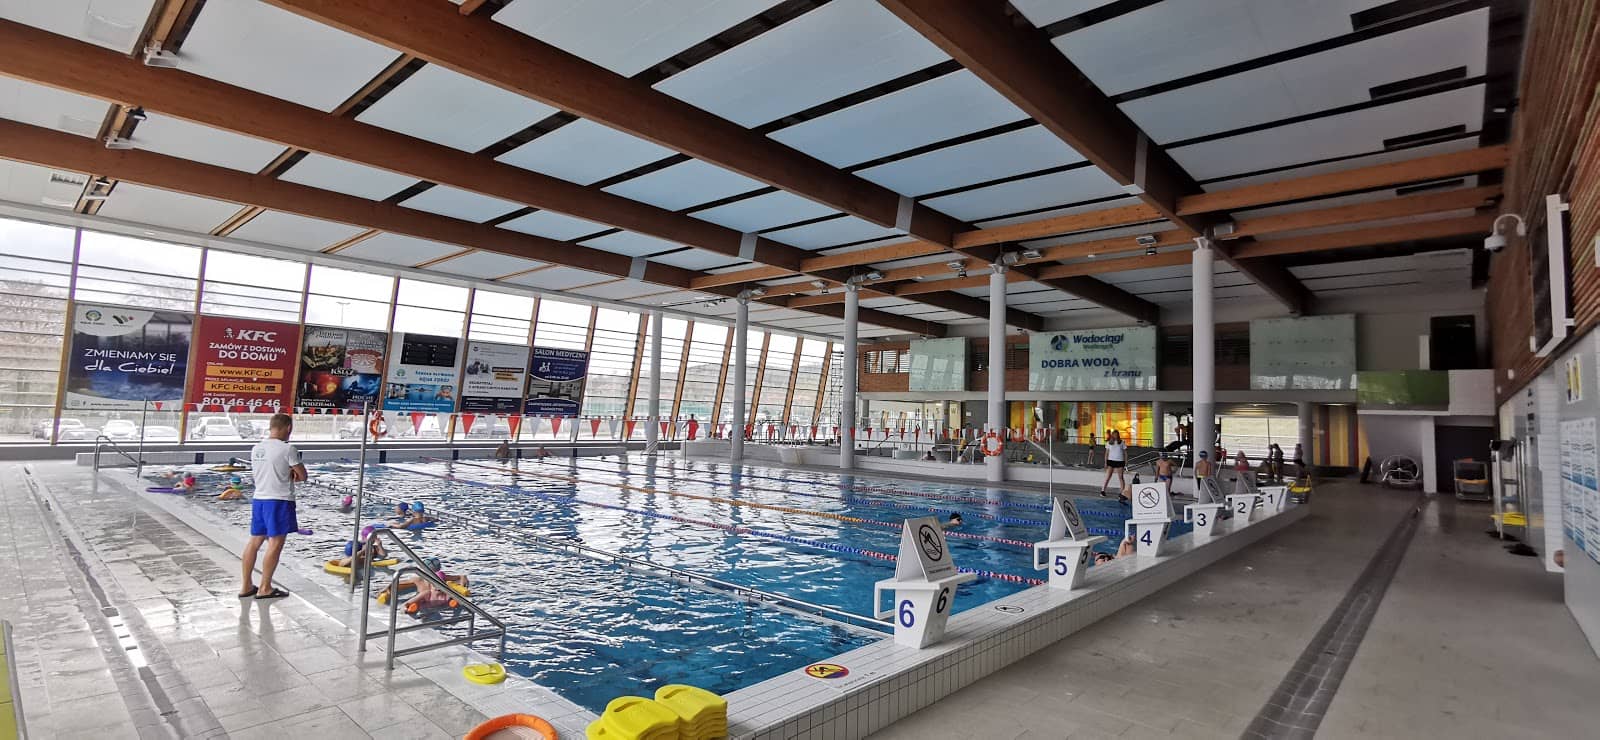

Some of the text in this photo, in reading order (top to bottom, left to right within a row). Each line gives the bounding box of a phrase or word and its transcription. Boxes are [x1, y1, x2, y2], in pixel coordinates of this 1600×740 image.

[236, 329, 277, 342] KFC
[84, 348, 157, 361] ZMIENIAMY
[209, 342, 242, 351] ZAMÓW
[250, 346, 287, 356] DOSTAWĄ
[218, 350, 277, 361] DO DOMU
[555, 350, 586, 359] MEDYCZNY
[84, 359, 175, 375] dla Ciebie!
[1041, 358, 1119, 369] DOBRA WODA
[219, 369, 273, 378] www.KFC.pl
[1111, 368, 1142, 378] kranu
[227, 398, 244, 407] 46
[246, 398, 263, 407] 46
[264, 399, 281, 408] 46
[1268, 494, 1274, 504] 1
[1237, 501, 1246, 513] 2
[1197, 513, 1207, 526] 3
[1140, 529, 1153, 546] 4
[1054, 555, 1068, 576] 5
[936, 587, 949, 614] 6
[899, 599, 915, 629] 6
